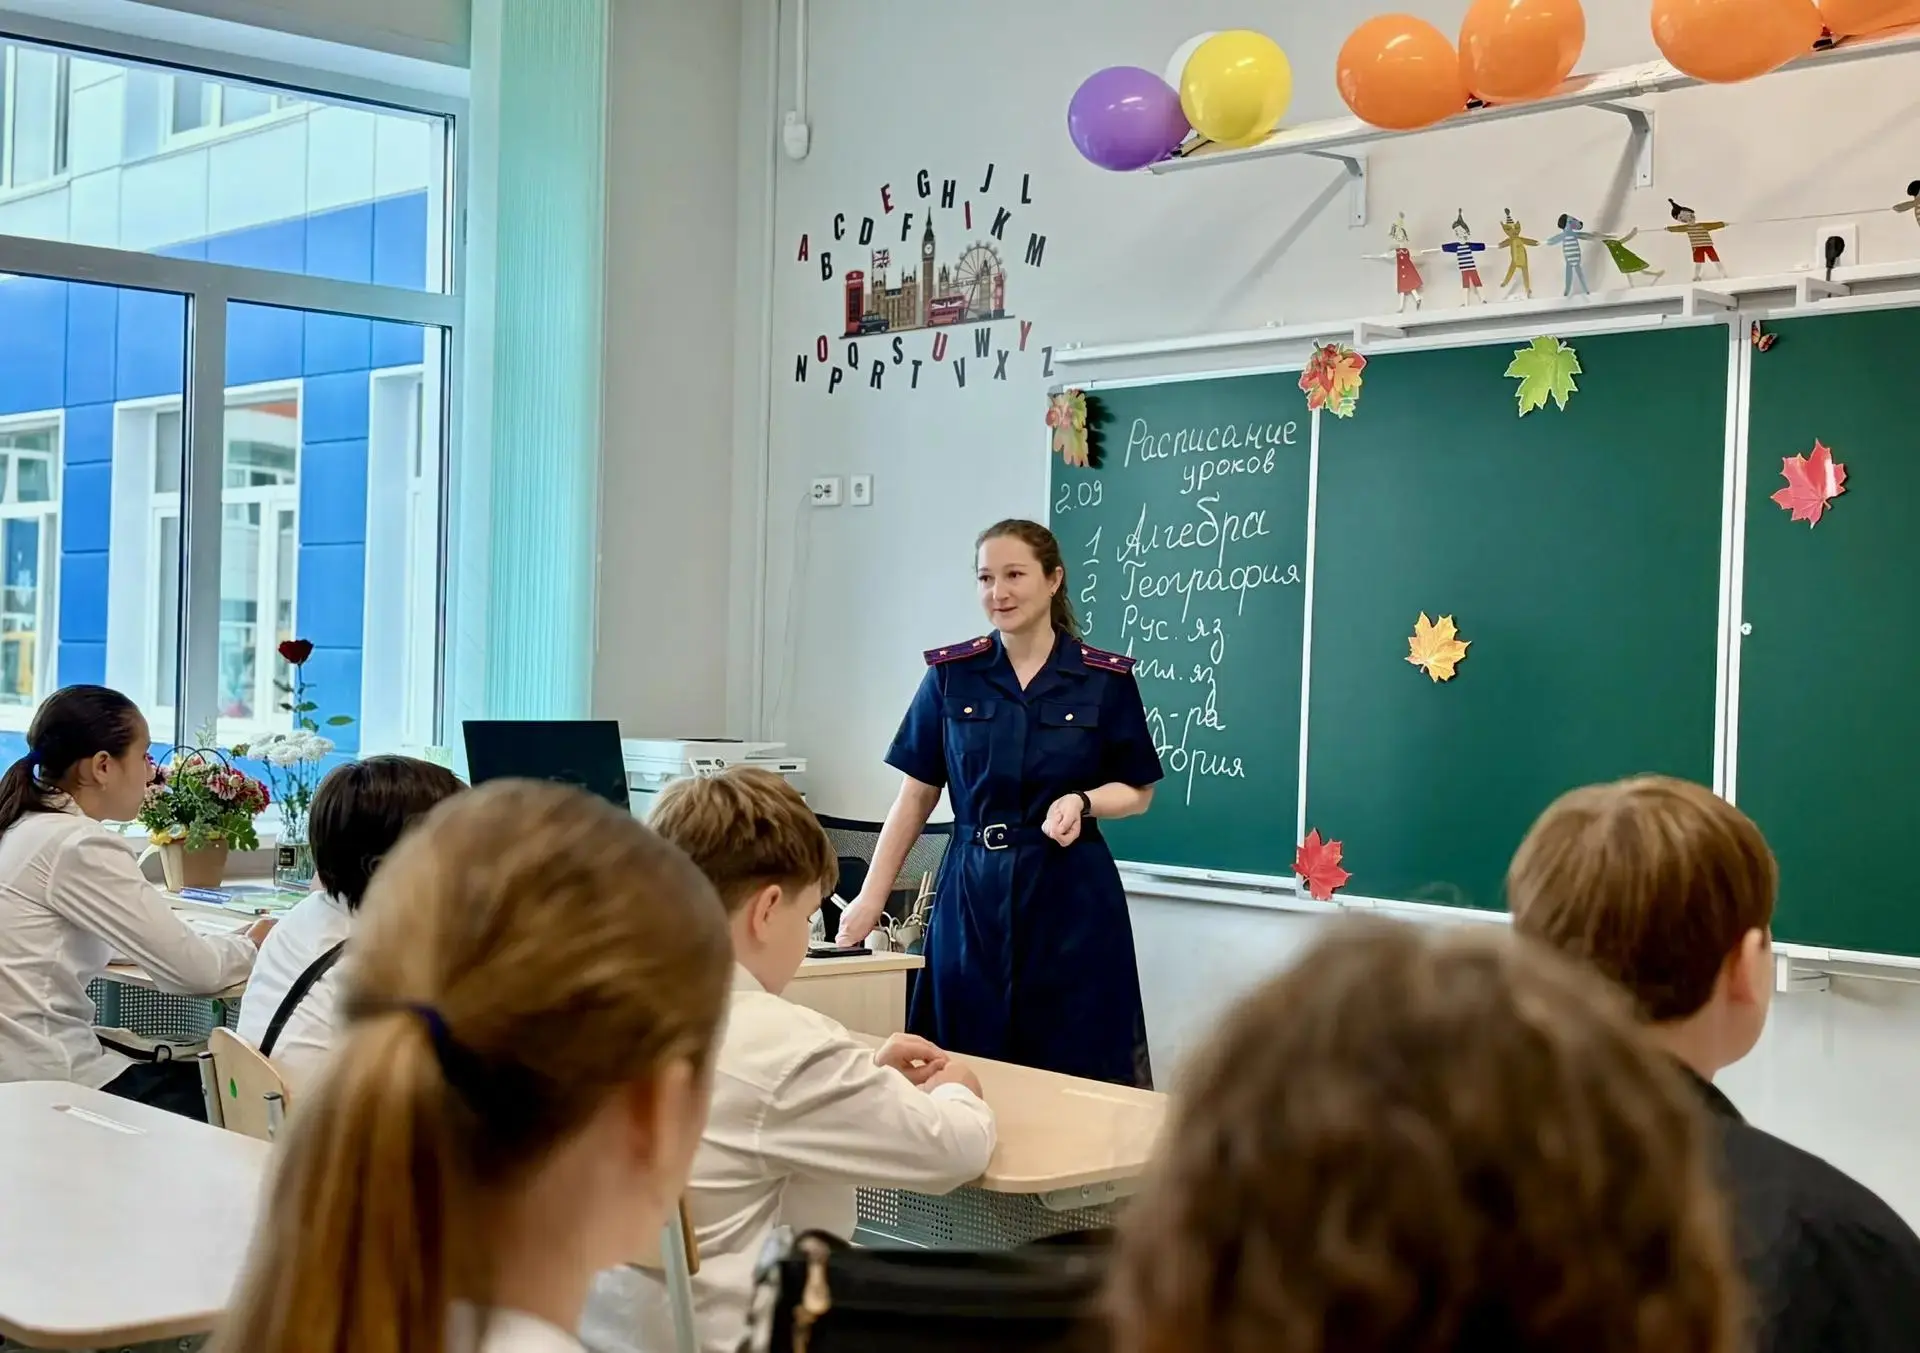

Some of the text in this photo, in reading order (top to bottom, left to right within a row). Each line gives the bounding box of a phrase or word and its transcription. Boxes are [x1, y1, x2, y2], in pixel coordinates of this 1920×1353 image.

[797, 163, 1047, 282] A B C D E F G H I J K L M
[795, 319, 1054, 395] N O P Q R S T U V W X Y Z
[1124, 418, 1298, 467] Расписание
[1180, 448, 1276, 494] уроков
[1055, 479, 1104, 514] 2.09
[1083, 491, 1270, 568] 1 Алгебра
[1080, 559, 1301, 623] 2 География
[1081, 611, 1093, 636] 3
[1188, 618, 1225, 665] яз
